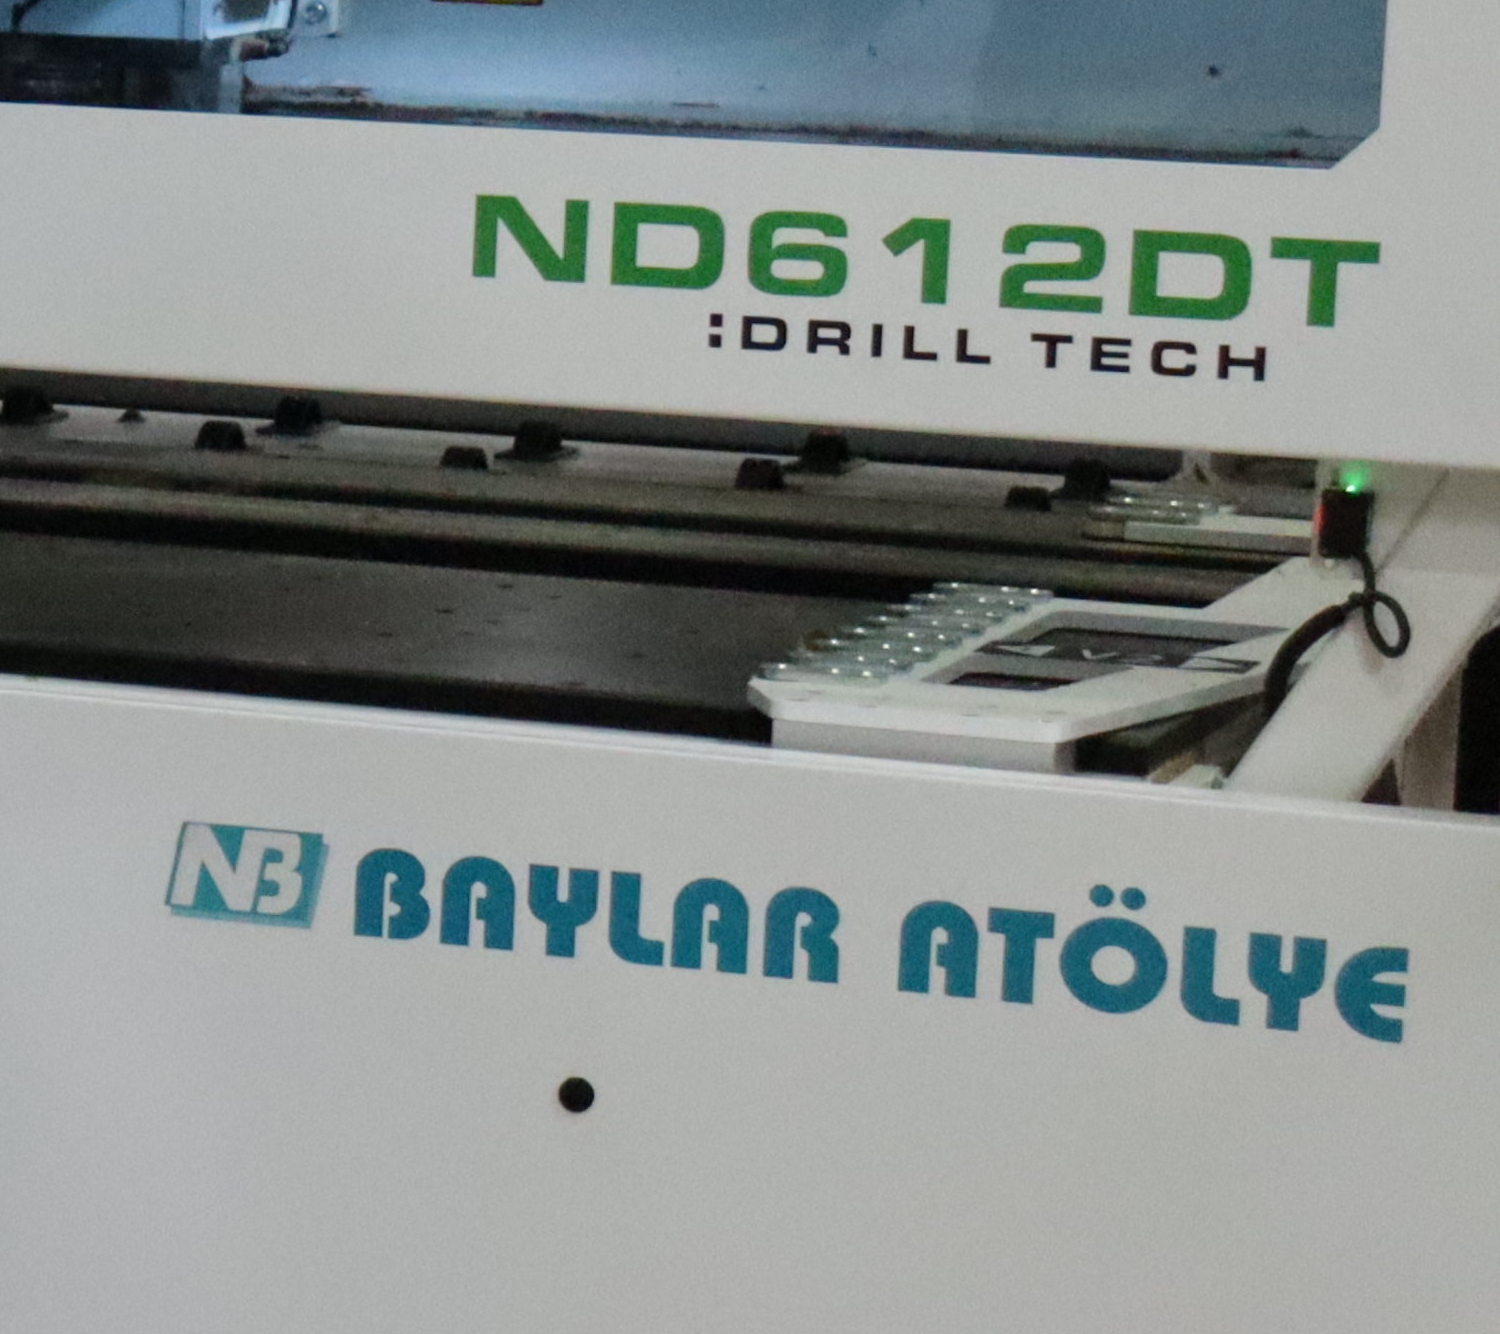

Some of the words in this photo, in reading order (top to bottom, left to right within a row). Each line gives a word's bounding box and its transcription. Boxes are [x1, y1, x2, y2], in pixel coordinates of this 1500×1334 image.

[472, 193, 1382, 329] ND612DT
[1029, 332, 1268, 383] TECH
[168, 822, 304, 916] NB
[353, 847, 842, 984] BAYLAR
[897, 883, 1410, 1045] ATÖLYE
